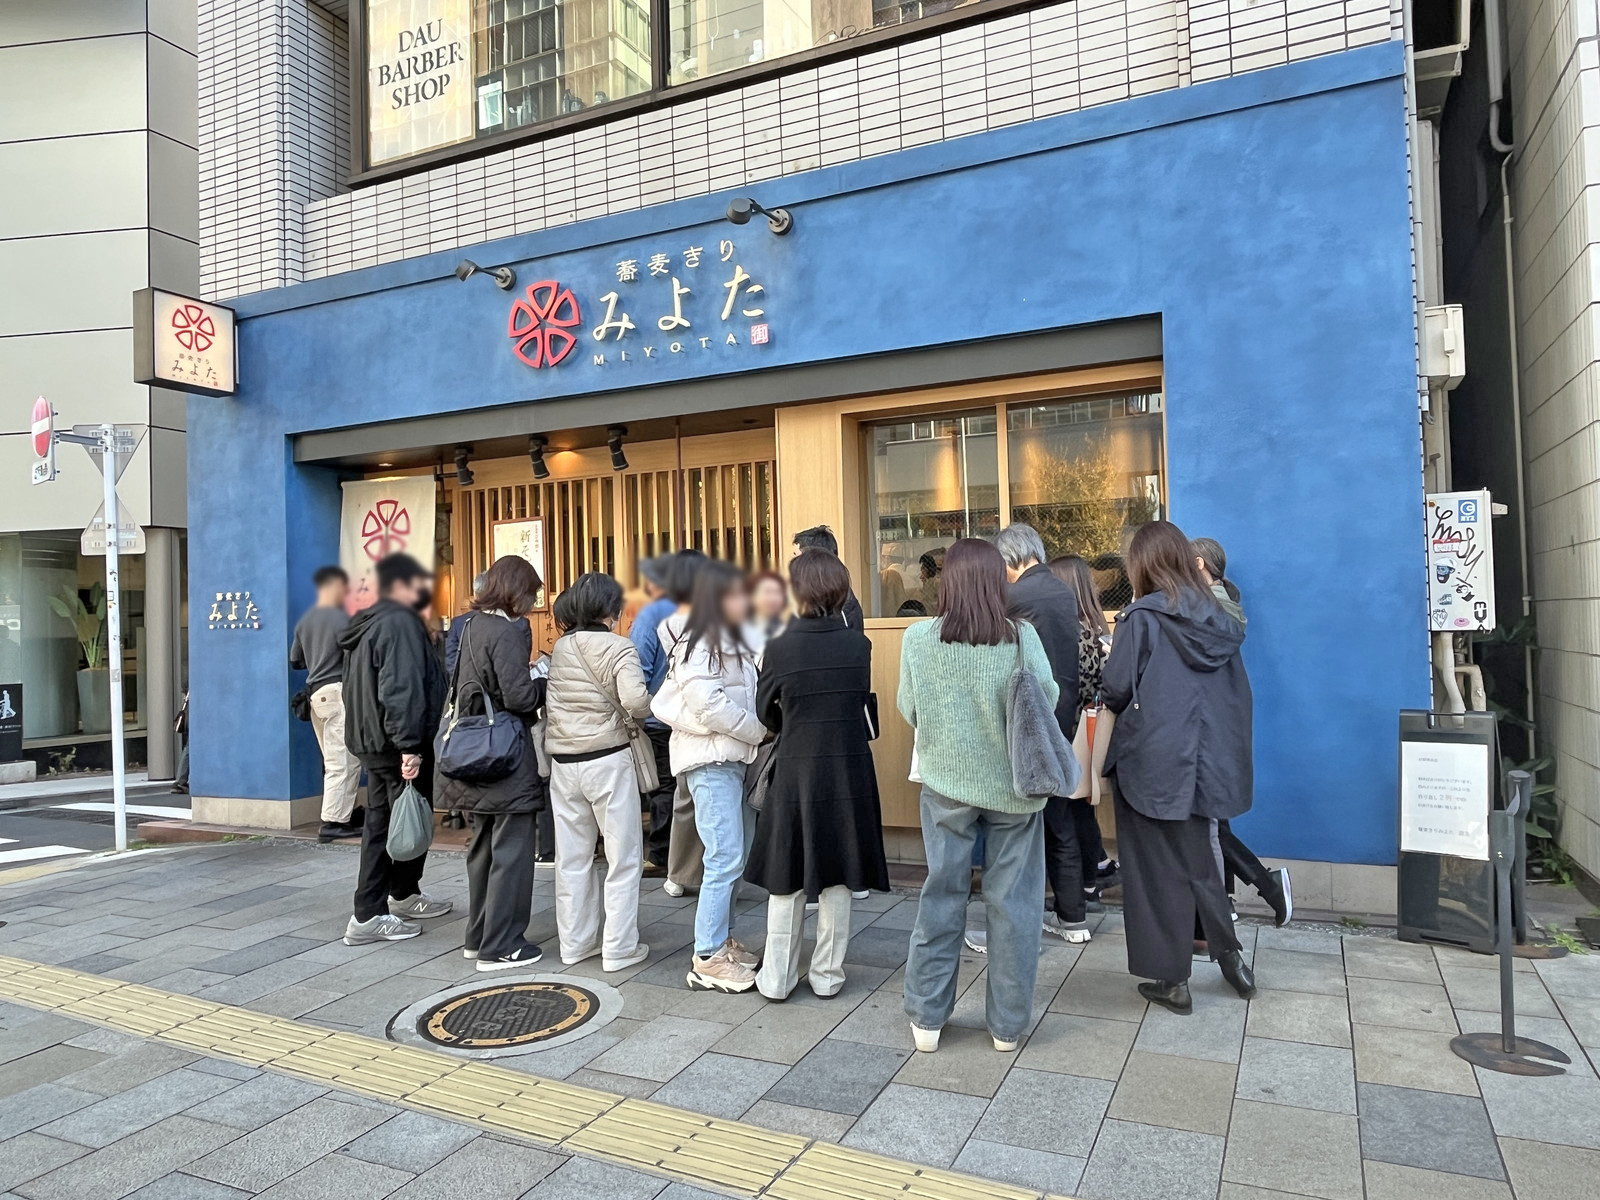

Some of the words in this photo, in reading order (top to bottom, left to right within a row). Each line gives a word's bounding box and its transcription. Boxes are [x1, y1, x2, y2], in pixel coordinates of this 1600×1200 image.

[398, 18, 443, 53] DAU
[378, 41, 464, 87] BARBER
[391, 73, 451, 110] SHOP
[616, 239, 735, 283] 蕎麦きり
[592, 264, 765, 342] みよた
[593, 332, 737, 366] MIYOTA
[171, 359, 217, 380] みよた
[208, 600, 258, 622] みよた
